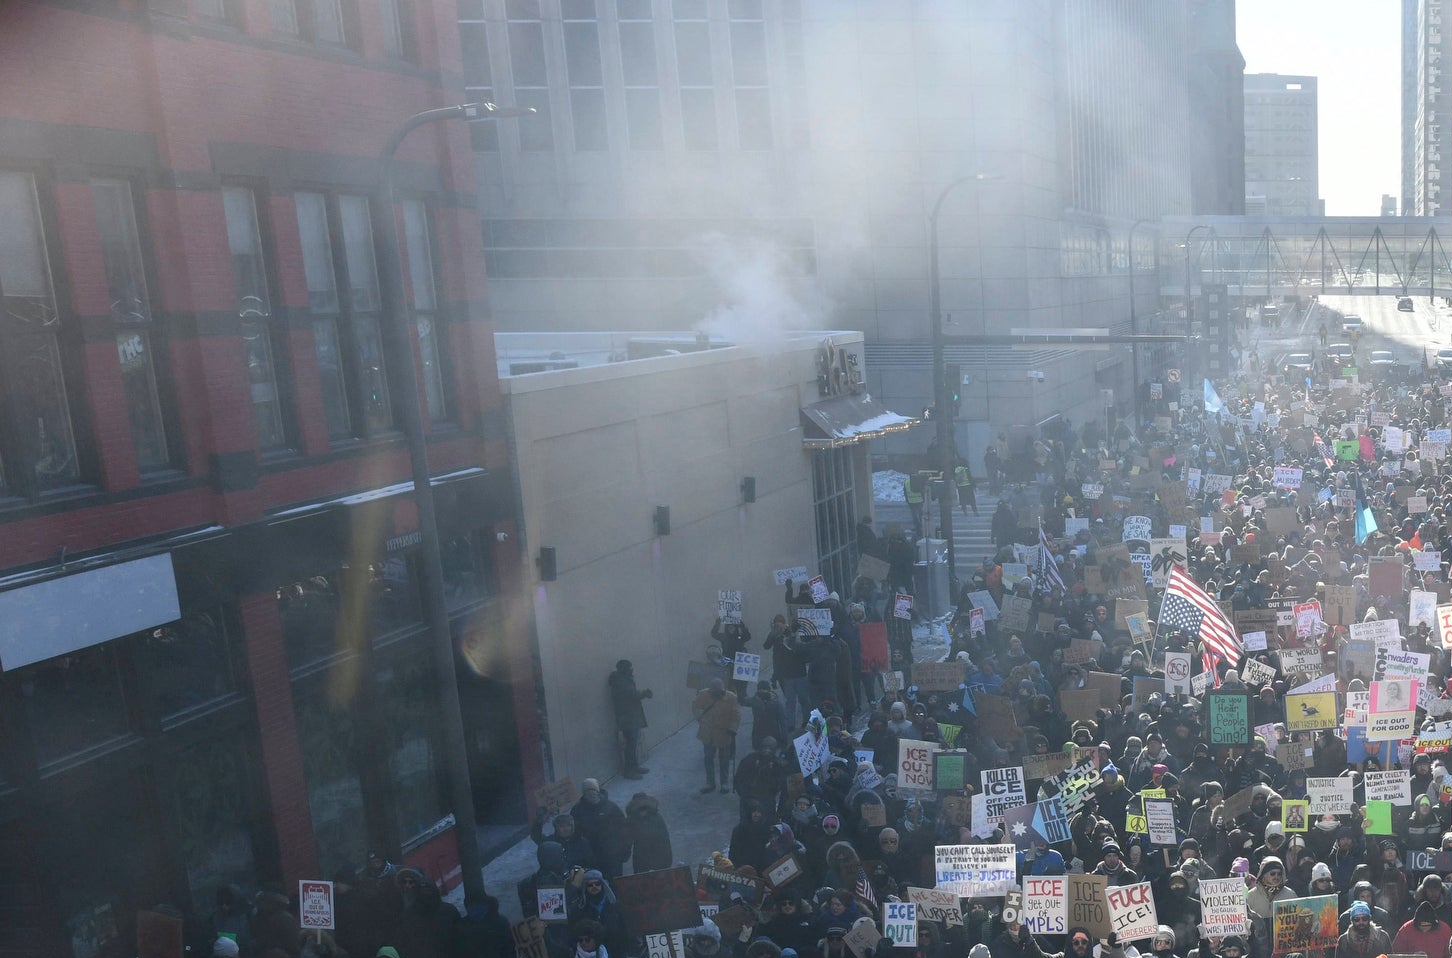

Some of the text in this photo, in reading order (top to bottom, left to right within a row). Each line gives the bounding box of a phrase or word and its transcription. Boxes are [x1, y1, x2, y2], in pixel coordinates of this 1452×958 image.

[737, 654, 758, 664] ICE
[737, 667, 758, 676] OUT
[1213, 728, 1246, 744] Sing?
[906, 748, 928, 760] ICE
[986, 771, 1018, 784] KILLER
[984, 782, 1021, 796] ICE
[986, 796, 1004, 804] OFF
[1038, 798, 1064, 822] ICE
[1027, 880, 1063, 896] ICE
[1201, 884, 1218, 895] YOU
[1108, 885, 1150, 910] FUCK
[1201, 895, 1244, 907] VIOLENCE
[888, 904, 915, 920] ICE
[1114, 906, 1152, 931] ICE!
[1025, 917, 1063, 932] MPLS
[1204, 914, 1246, 924] LEARNING
[1205, 923, 1244, 934] WAS HARD
